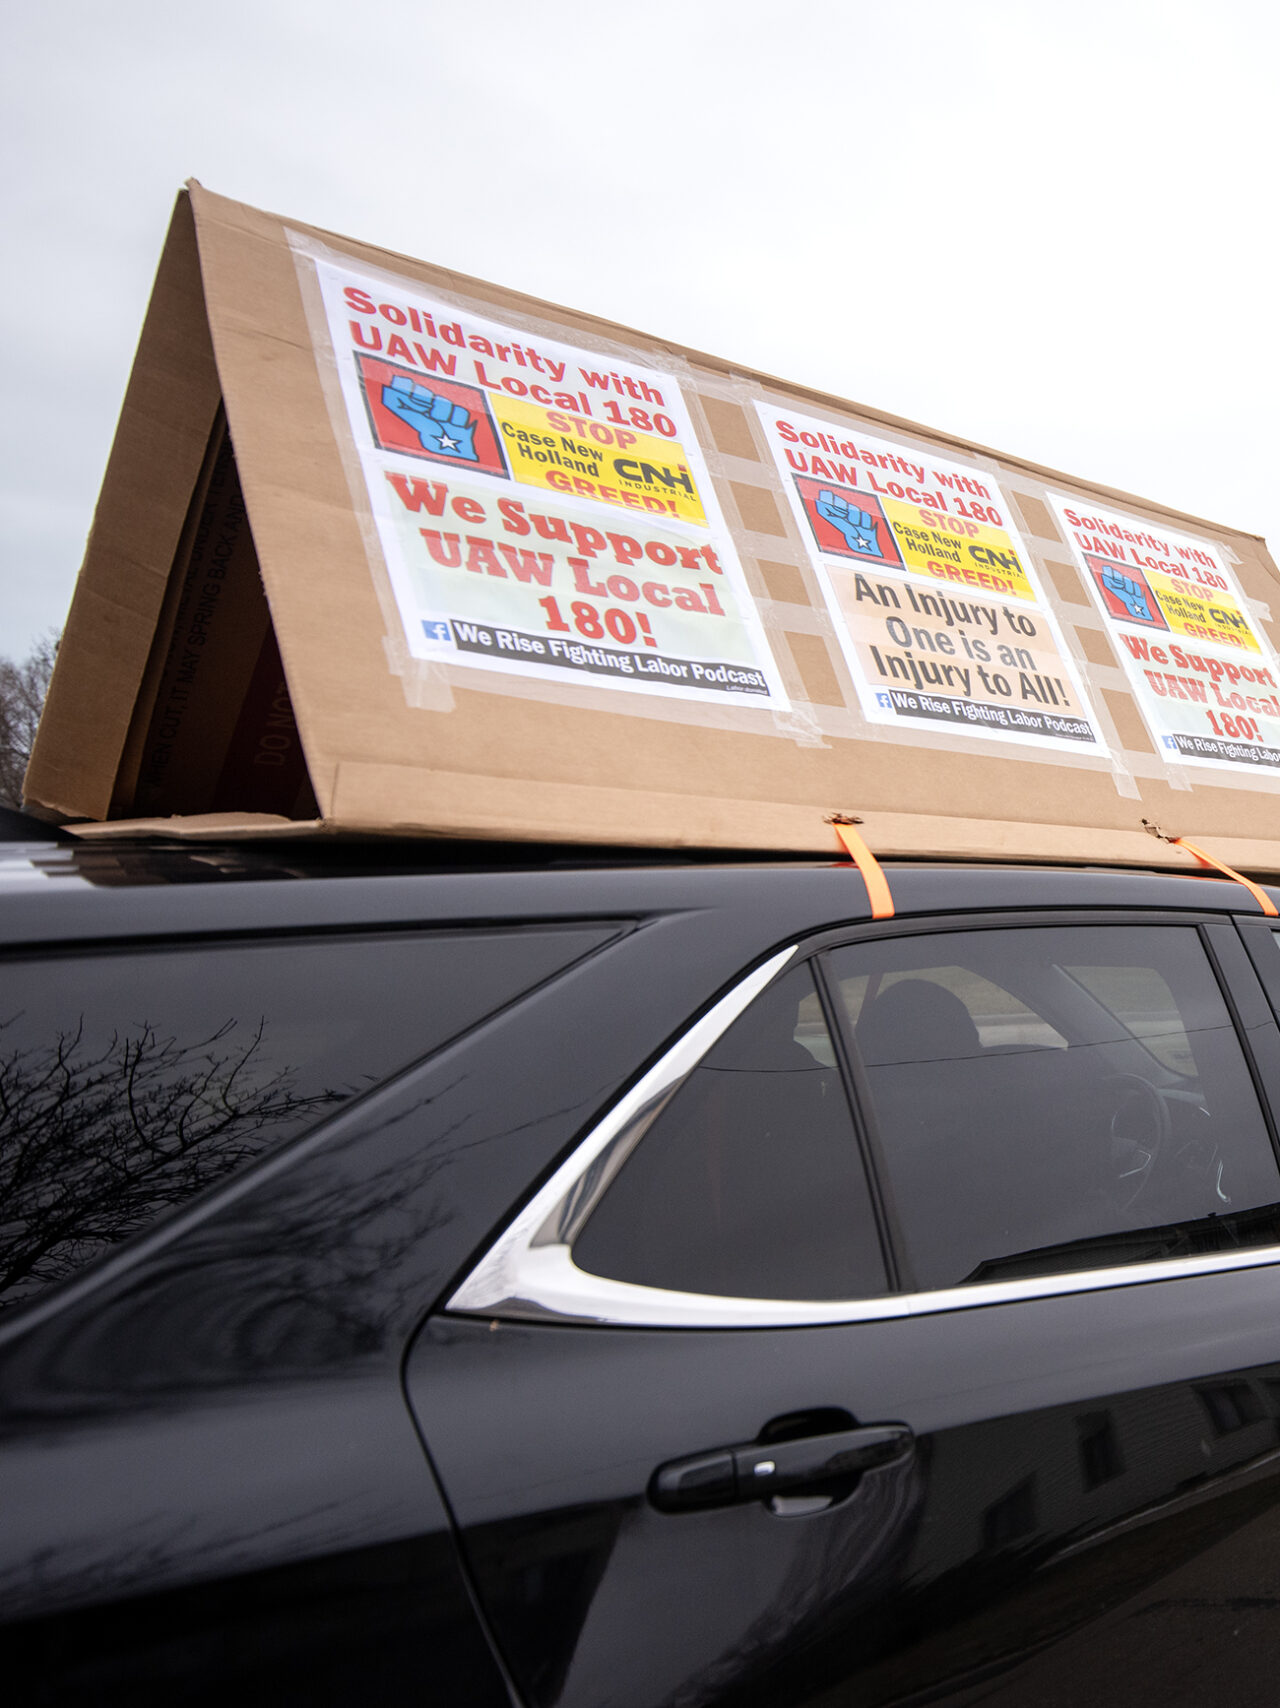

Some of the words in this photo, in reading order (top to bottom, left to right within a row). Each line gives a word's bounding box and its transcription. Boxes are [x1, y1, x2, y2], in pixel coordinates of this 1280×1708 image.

[342, 285, 566, 382] Solidarity
[578, 364, 665, 407] with
[348, 320, 456, 376] UAW
[476, 360, 592, 415] Local
[607, 400, 678, 438] 180
[501, 421, 557, 451] Case
[561, 437, 604, 463] New
[546, 412, 638, 450] STOP
[518, 443, 600, 478] Holland
[776, 420, 926, 484] Solidarity
[933, 470, 992, 501] with
[545, 471, 680, 519] GREED!
[618, 479, 697, 502] INDUSTRIAL
[784, 449, 858, 487] UAW
[867, 472, 948, 511] Local
[953, 496, 1003, 527] 180
[384, 471, 486, 525] We
[499, 498, 724, 575] Support
[893, 521, 931, 543] Case
[933, 532, 962, 550] New
[919, 509, 981, 538] STOP
[1063, 508, 1172, 557] Solidarity
[1174, 544, 1217, 570] with
[419, 528, 554, 587] UAW
[567, 557, 726, 617] Local
[908, 539, 961, 563] Holland
[1073, 532, 1127, 561] UAW
[1131, 549, 1189, 580] Local
[1192, 566, 1229, 591] 180
[926, 561, 1017, 596] GREED!
[1156, 590, 1183, 608] Case
[1183, 598, 1206, 613] New
[1170, 578, 1214, 602] STOP
[538, 595, 658, 648] 180!
[855, 573, 901, 609] An
[907, 584, 998, 637] Injury
[1003, 609, 1037, 638] to
[1166, 604, 1205, 624] Holland
[453, 622, 492, 649] We
[496, 630, 547, 660] Rise
[550, 641, 635, 674] Fighting
[635, 654, 688, 680] Labor
[691, 663, 766, 688] Podcast
[886, 616, 956, 656] One
[960, 630, 992, 663] is
[999, 645, 1037, 672] an
[1183, 622, 1248, 651] GREED!
[870, 646, 971, 698] Injury
[977, 667, 1012, 697] to
[1020, 673, 1071, 708] All!
[1118, 633, 1167, 666] We
[1172, 644, 1278, 689] Support
[1144, 670, 1209, 704] UAW
[891, 691, 917, 710] We
[919, 697, 951, 715] Rise
[952, 703, 1009, 725] Fighting
[1009, 712, 1043, 729] Labor
[1043, 715, 1094, 737] Podcast
[1206, 709, 1264, 743] 180!
[1177, 735, 1194, 752] We
[1194, 738, 1218, 754] Rise
[1218, 742, 1259, 762] Fighting
